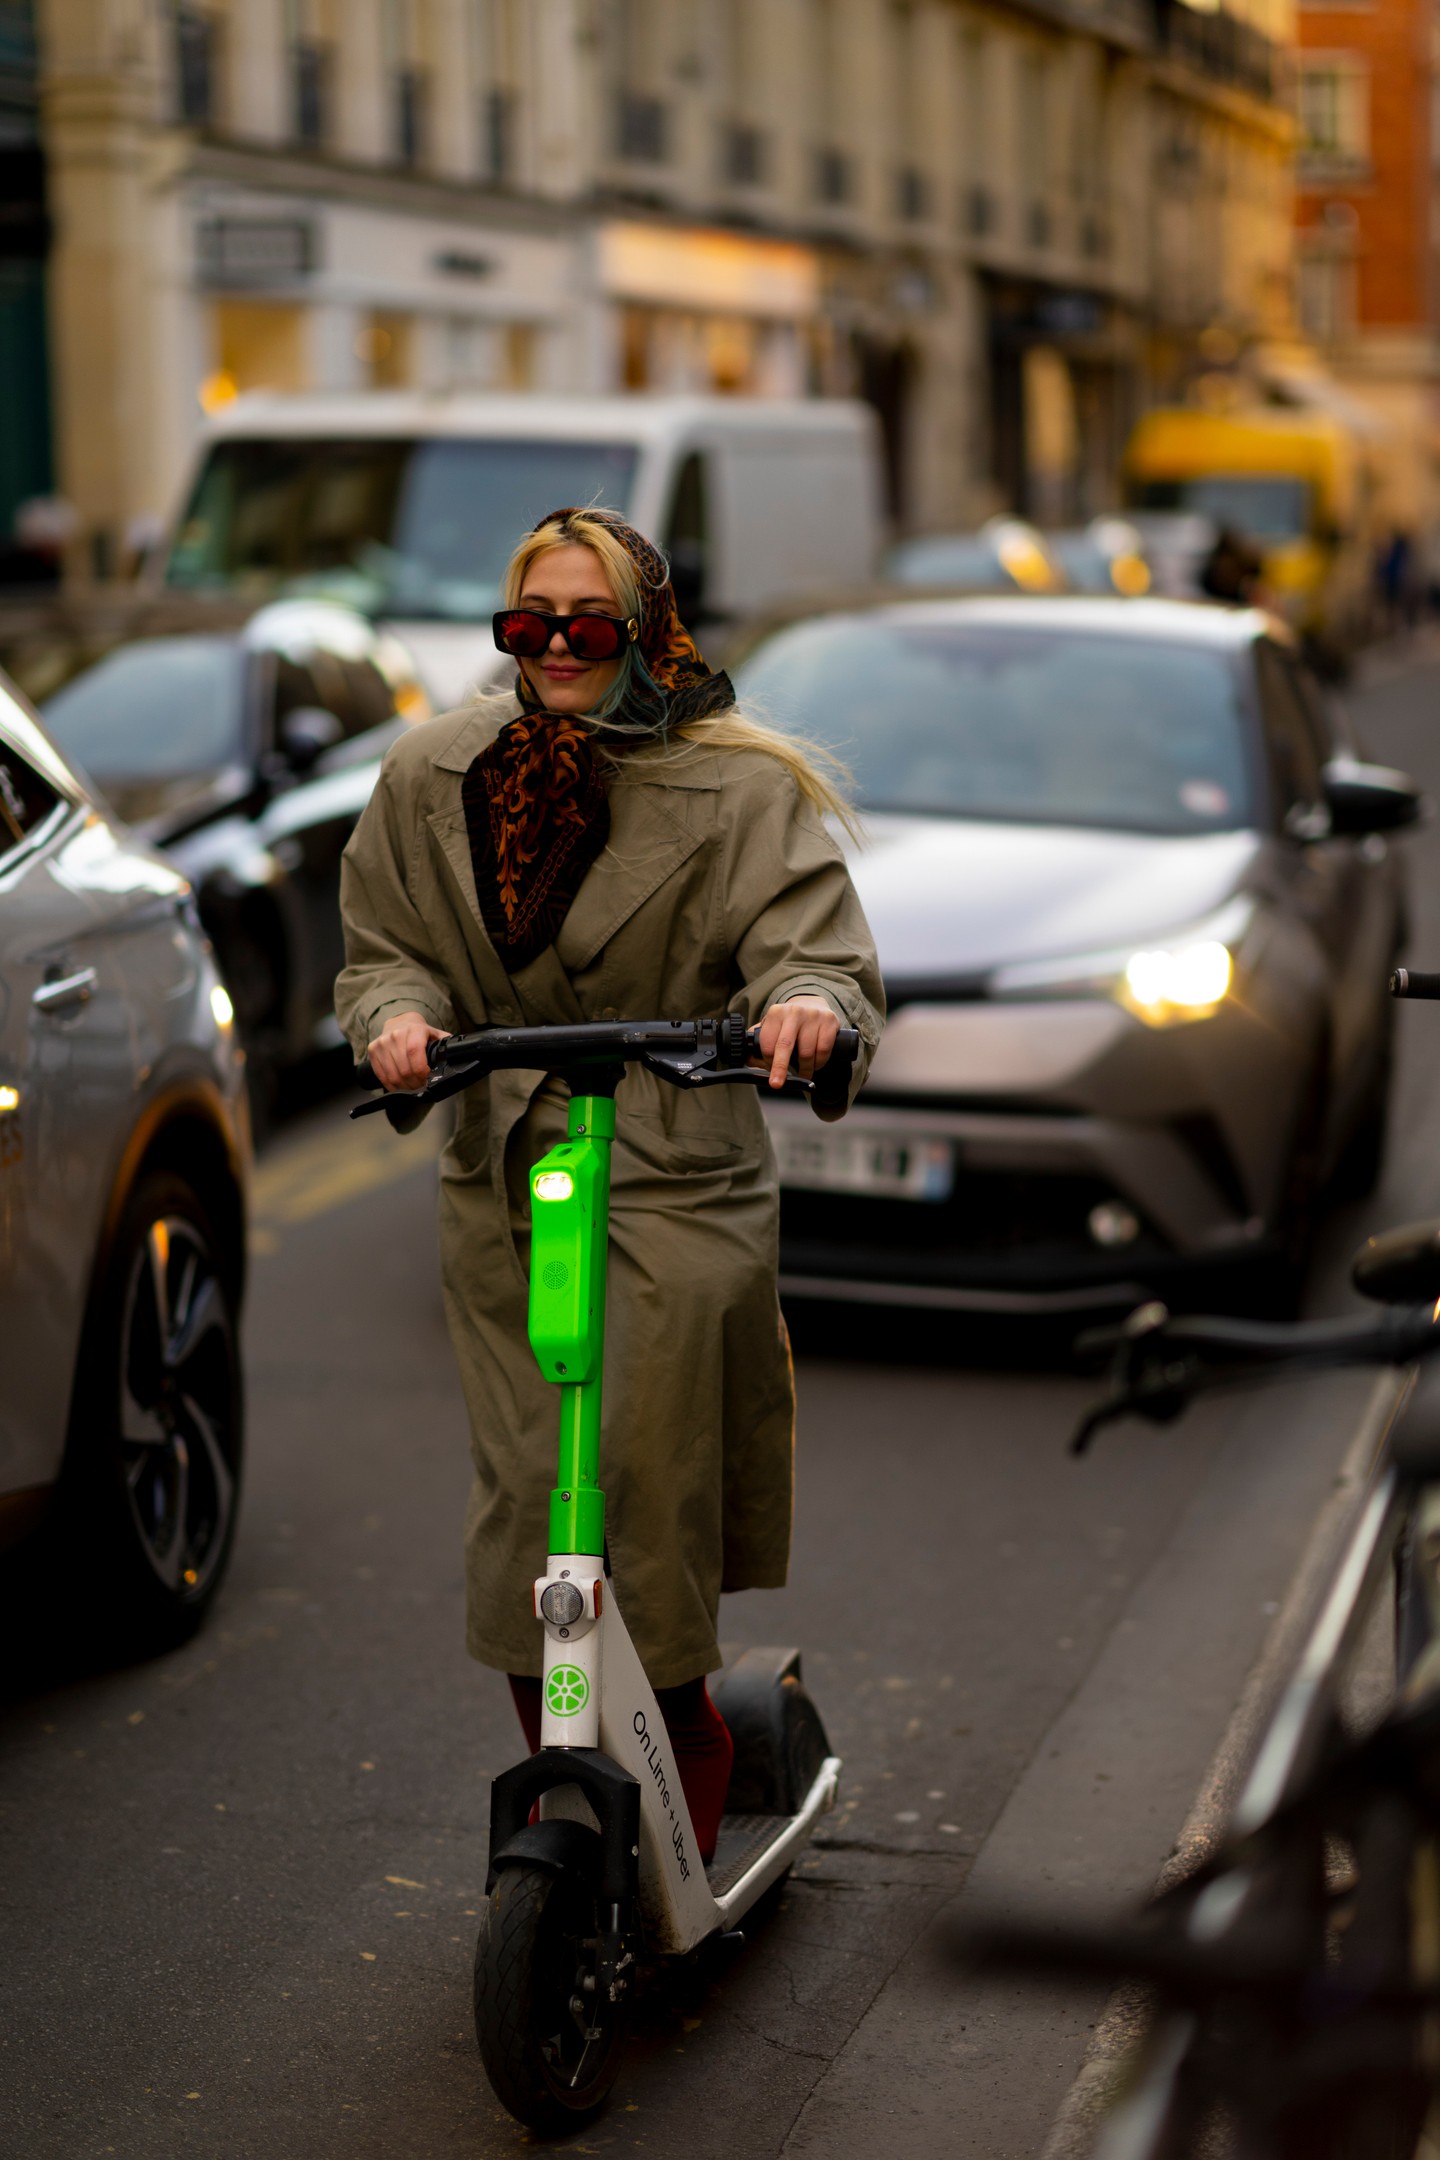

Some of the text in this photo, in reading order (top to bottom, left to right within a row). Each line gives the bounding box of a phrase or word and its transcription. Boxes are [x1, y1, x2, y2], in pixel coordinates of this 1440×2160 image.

[633, 1711, 651, 1752] On
[648, 1746, 670, 1808] Lime
[672, 1821, 691, 1882] Uber
